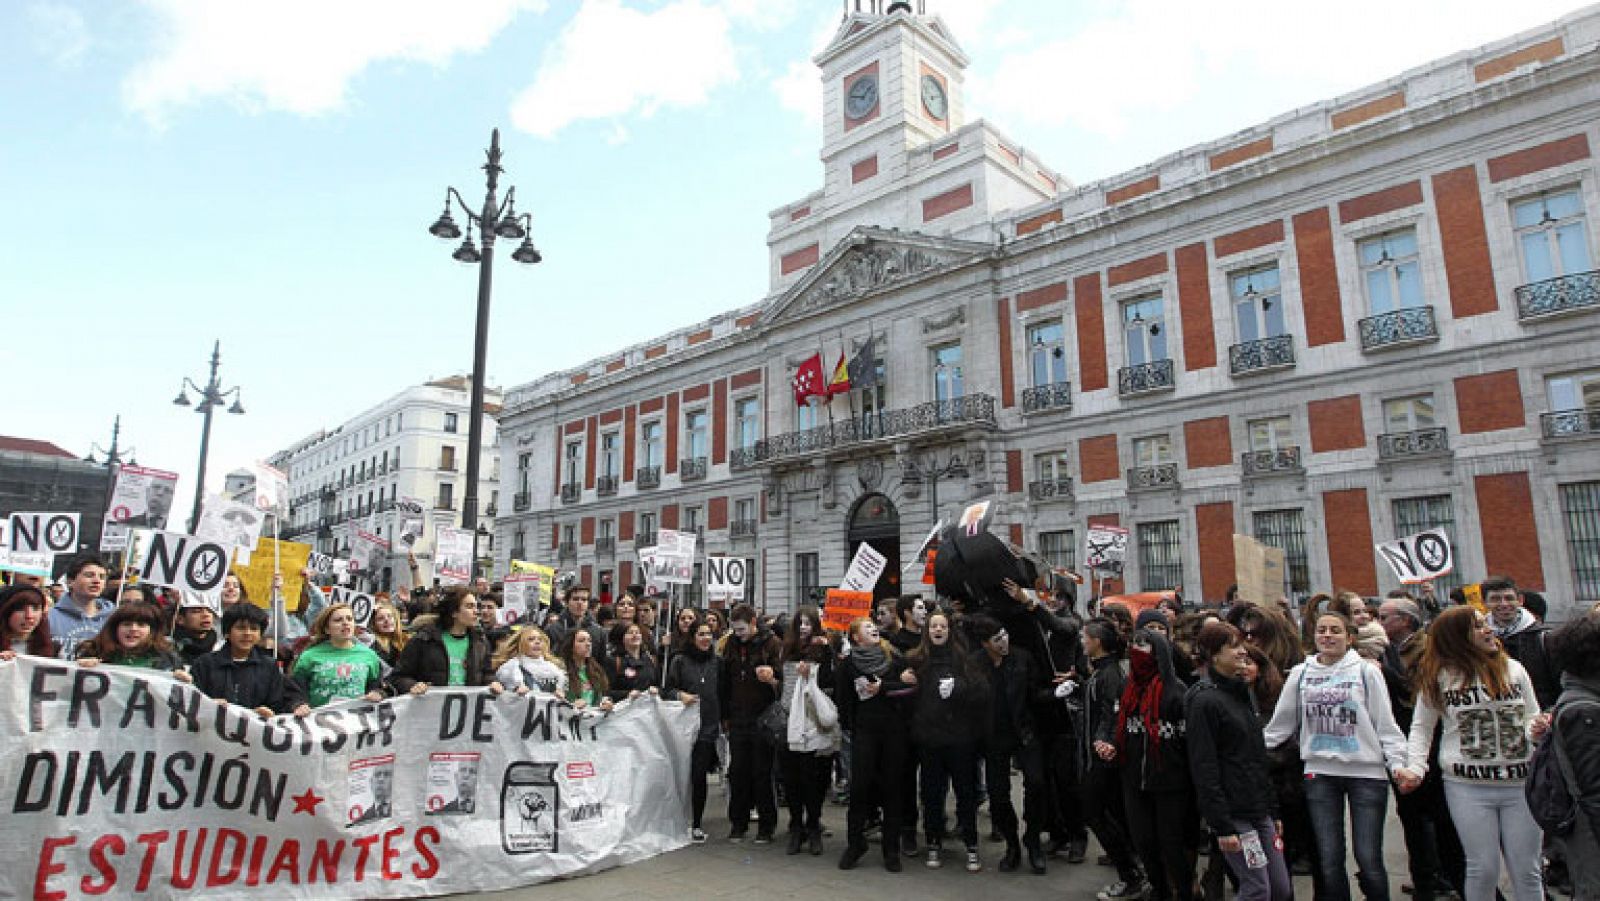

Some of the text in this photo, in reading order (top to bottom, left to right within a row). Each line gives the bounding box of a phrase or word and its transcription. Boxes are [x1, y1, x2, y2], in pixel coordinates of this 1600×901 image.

[12, 515, 76, 551] NO
[1381, 533, 1449, 576] NO
[142, 533, 227, 590] NO
[707, 558, 744, 585] NO
[439, 693, 497, 742] DE
[12, 750, 289, 822] DIMISIÓN
[33, 825, 441, 901] ESTUDIANTES
